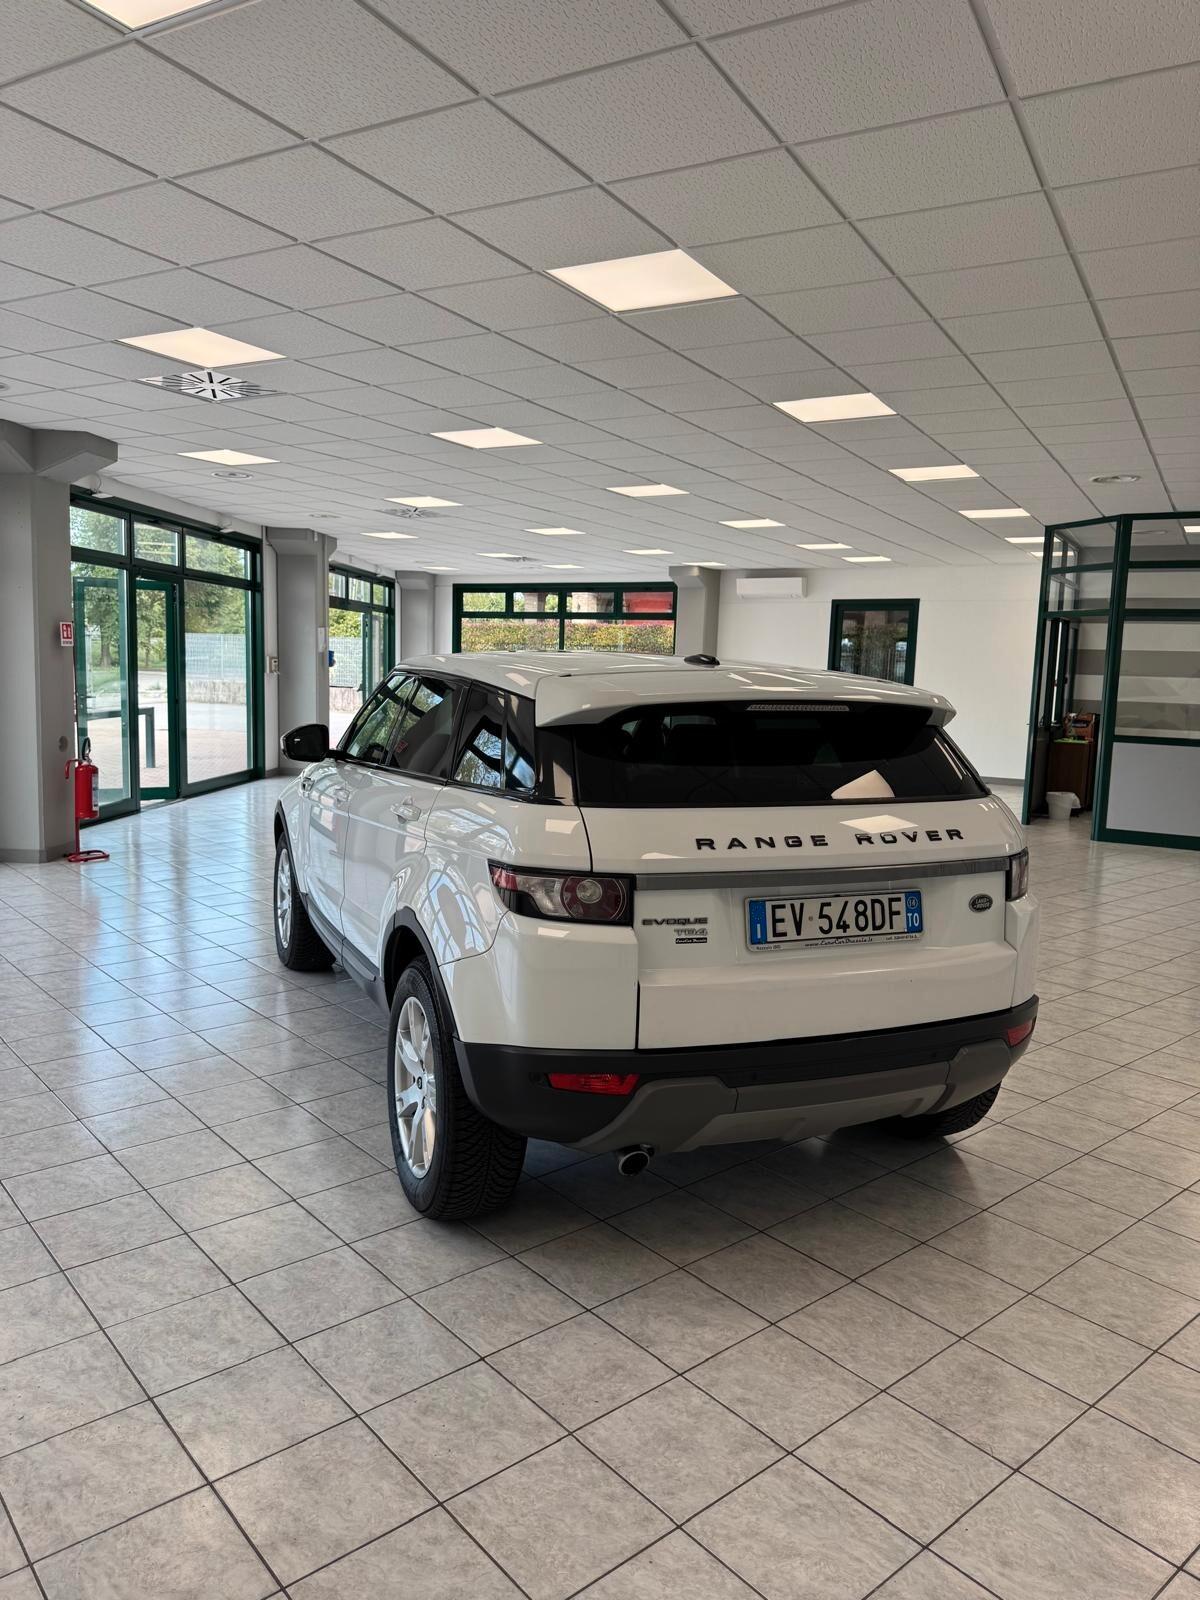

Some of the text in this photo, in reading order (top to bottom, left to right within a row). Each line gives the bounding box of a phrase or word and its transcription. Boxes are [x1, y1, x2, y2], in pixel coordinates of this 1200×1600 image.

[696, 829, 964, 850] RANGE ROVER
[641, 917, 708, 926] EVOQUE
[771, 897, 902, 938] EV 548DF
[907, 912, 920, 928] TO
